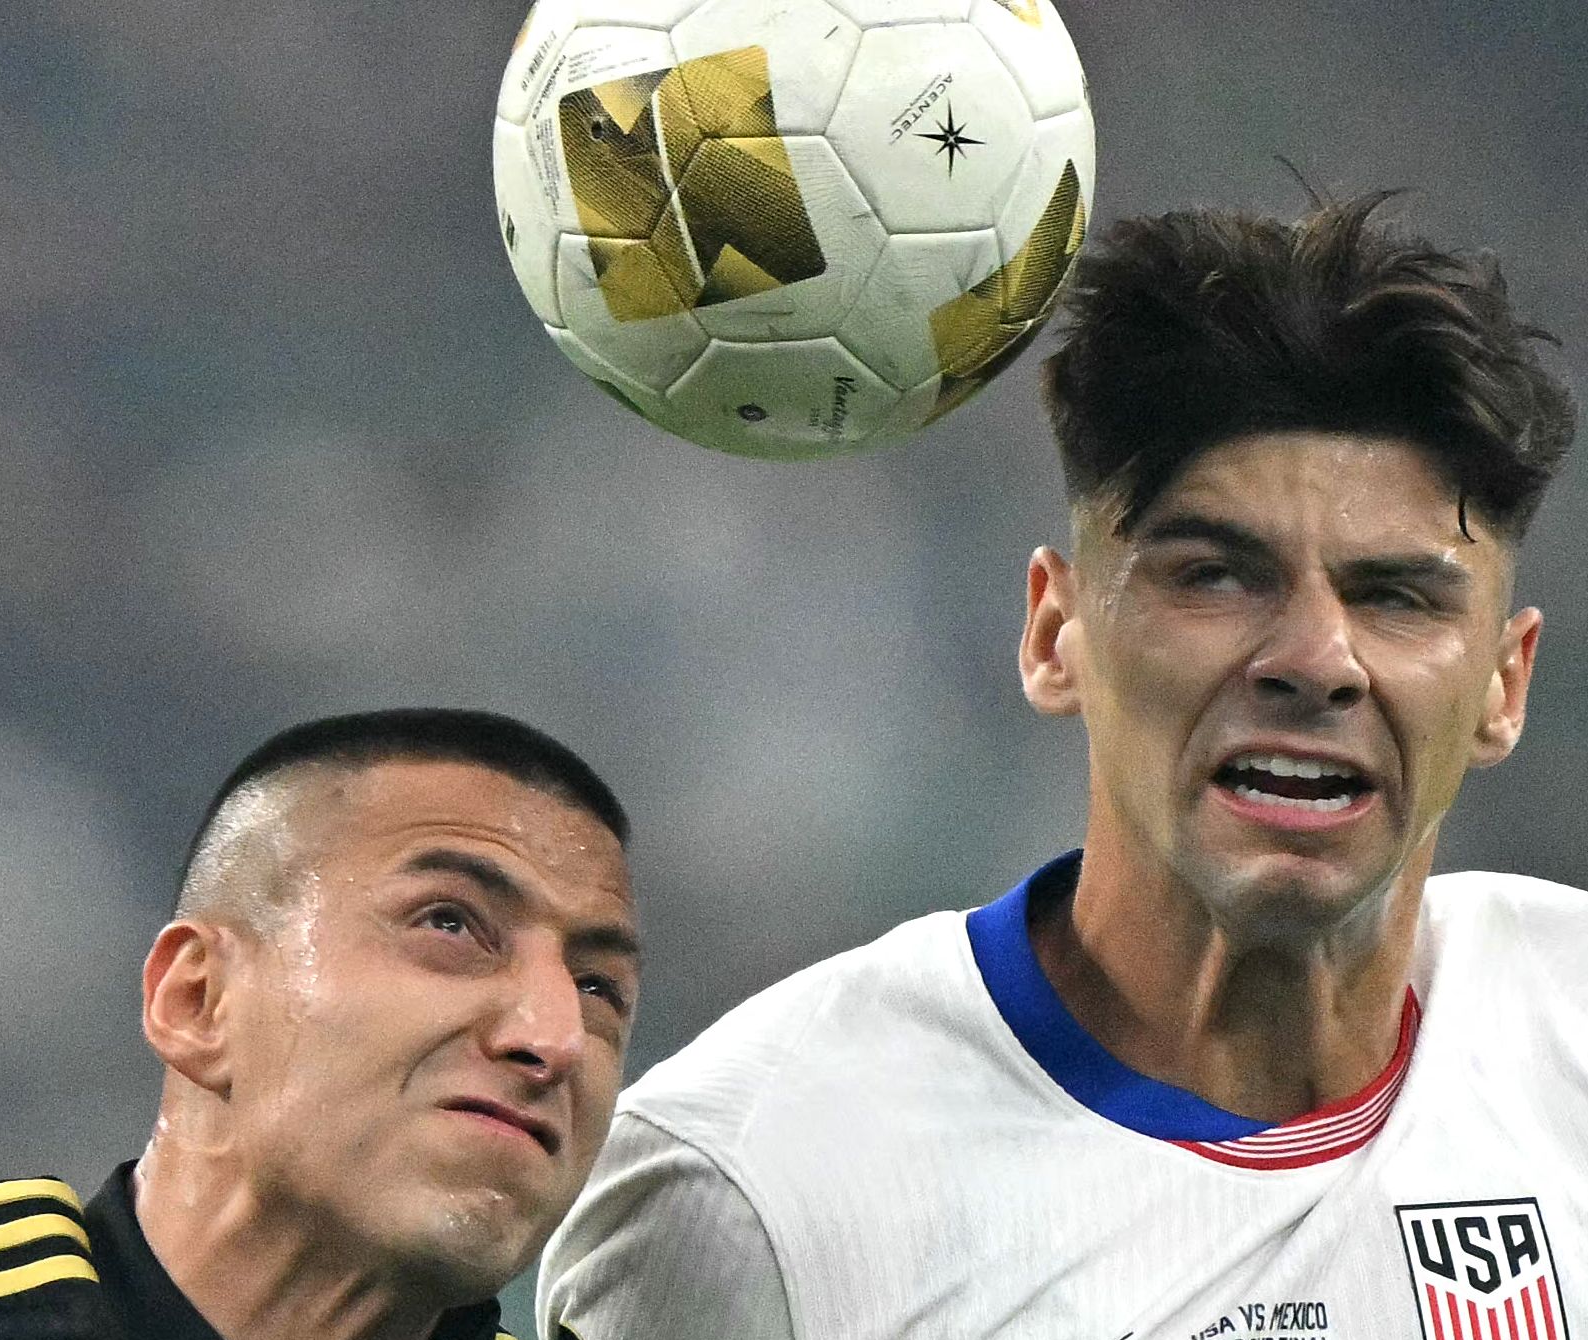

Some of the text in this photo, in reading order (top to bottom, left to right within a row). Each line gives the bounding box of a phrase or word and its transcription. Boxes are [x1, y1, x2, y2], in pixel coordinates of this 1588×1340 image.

[890, 73, 953, 141] ACENTEC
[1410, 1213, 1540, 1295] USA
[1269, 1301, 1329, 1331] MEXICO
